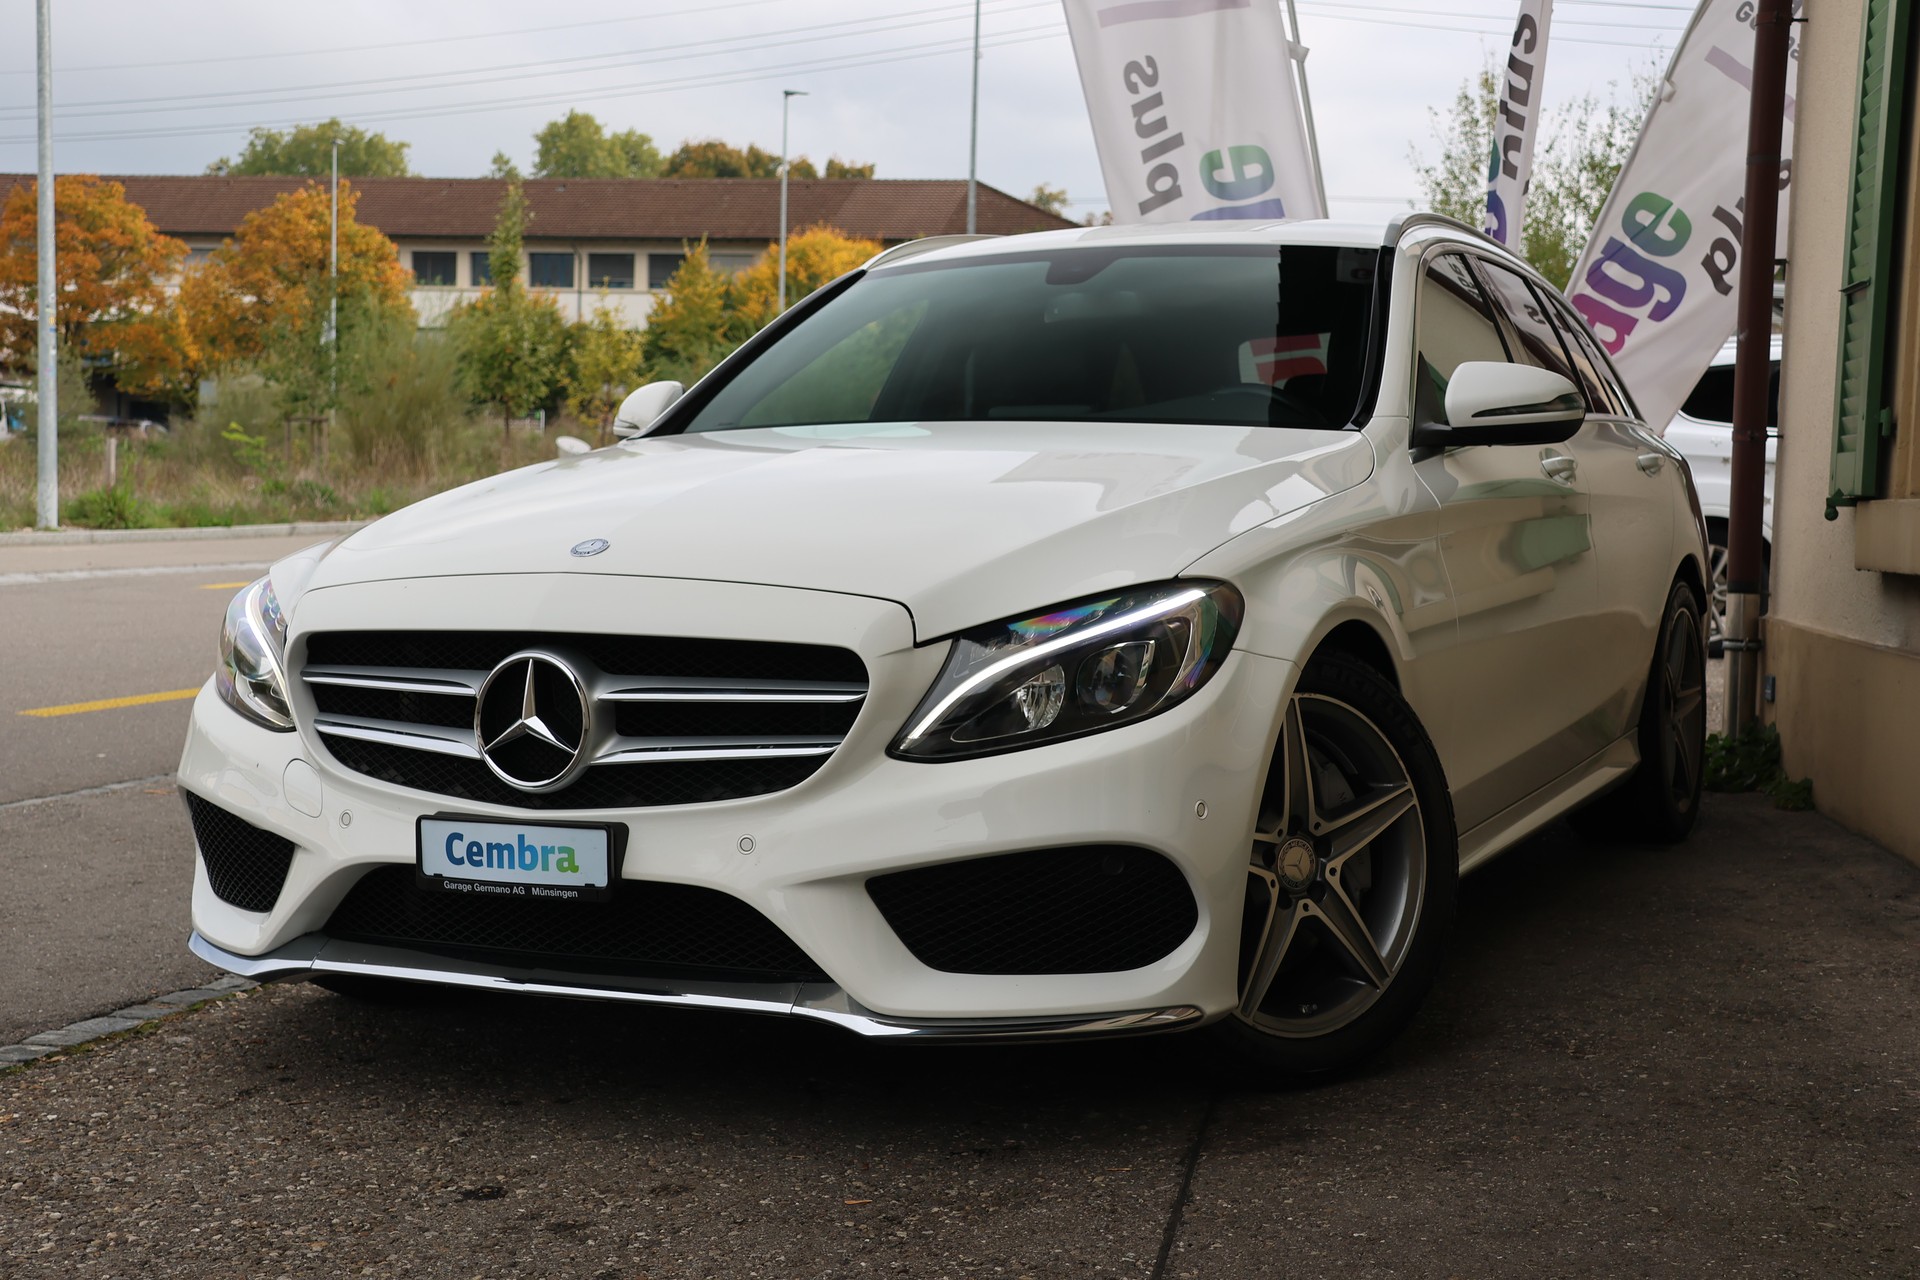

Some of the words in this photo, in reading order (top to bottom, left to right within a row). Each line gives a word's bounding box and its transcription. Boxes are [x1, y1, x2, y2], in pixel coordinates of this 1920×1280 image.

[445, 832, 579, 873] Cembra
[443, 880, 473, 891] Garage
[474, 883, 511, 894] Germano
[512, 886, 526, 895] AG
[531, 887, 578, 898] Münsingen
